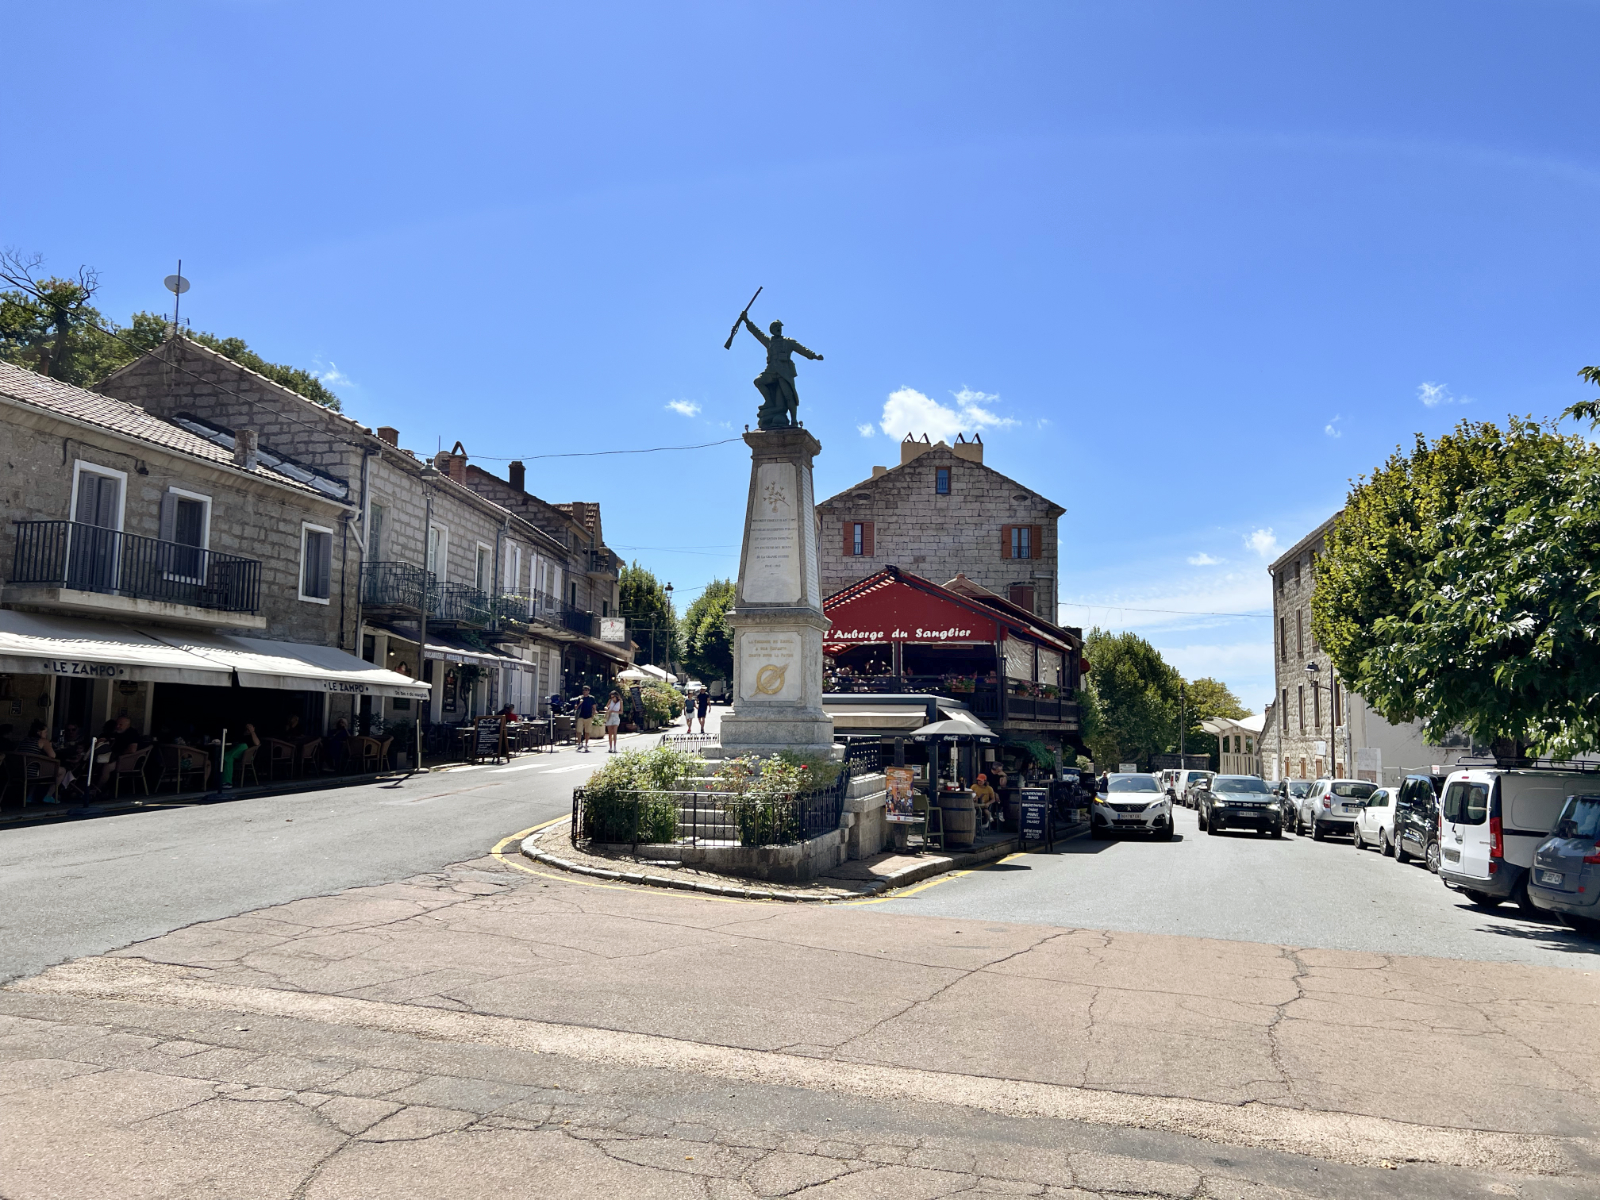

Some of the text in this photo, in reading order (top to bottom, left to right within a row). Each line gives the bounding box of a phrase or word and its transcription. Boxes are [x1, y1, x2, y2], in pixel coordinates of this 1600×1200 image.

[823, 628, 971, 640] L'Auberge du Sanglier
[53, 661, 116, 676] LE ZAMPO
[328, 682, 364, 692] LE ZAMPO
